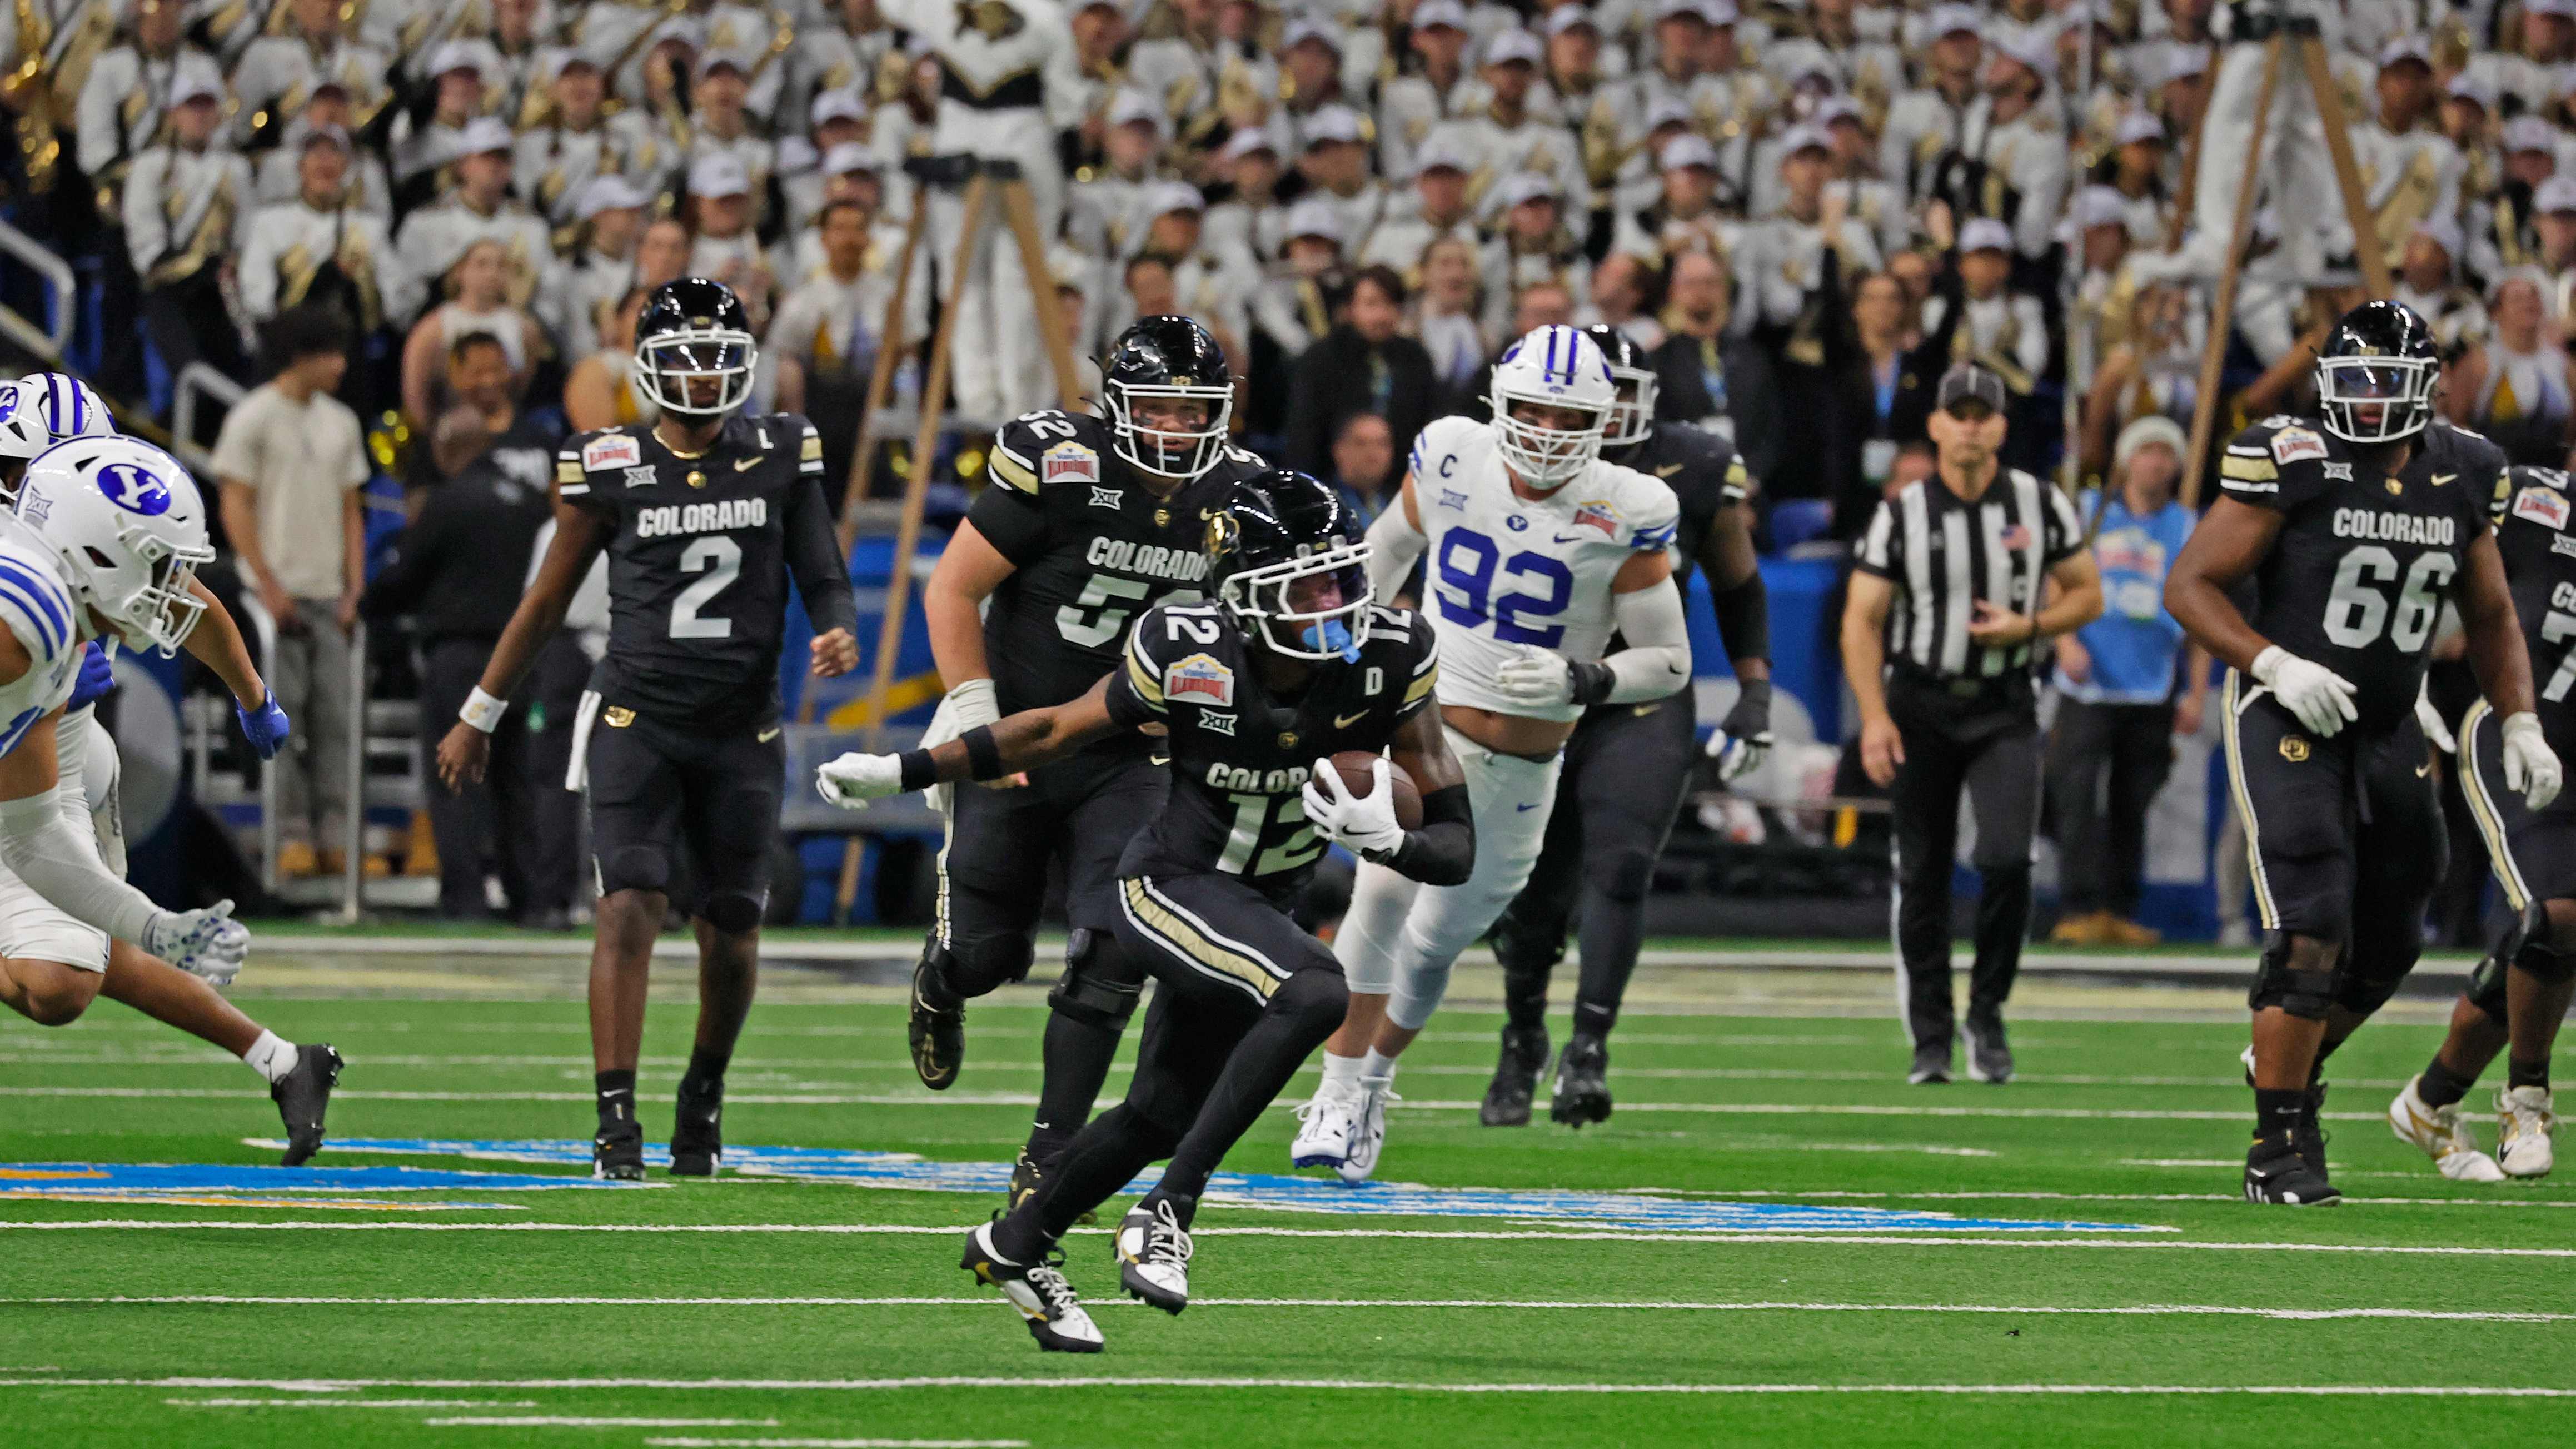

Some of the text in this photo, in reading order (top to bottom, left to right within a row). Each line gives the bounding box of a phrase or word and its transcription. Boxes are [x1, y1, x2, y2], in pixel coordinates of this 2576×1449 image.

[757, 427, 774, 449] L
[1439, 454, 1458, 478] C
[637, 497, 766, 538] COLORADO
[2333, 507, 2455, 546] COLORADO
[669, 536, 742, 638] 2
[1434, 525, 1573, 649] 92
[2323, 545, 2457, 653] 66
[1056, 573, 1203, 656] 5
[1164, 605, 1220, 644] 12
[1365, 666, 1384, 696] D
[1206, 762, 1308, 793] COLOR
[1215, 793, 1323, 877] 12
